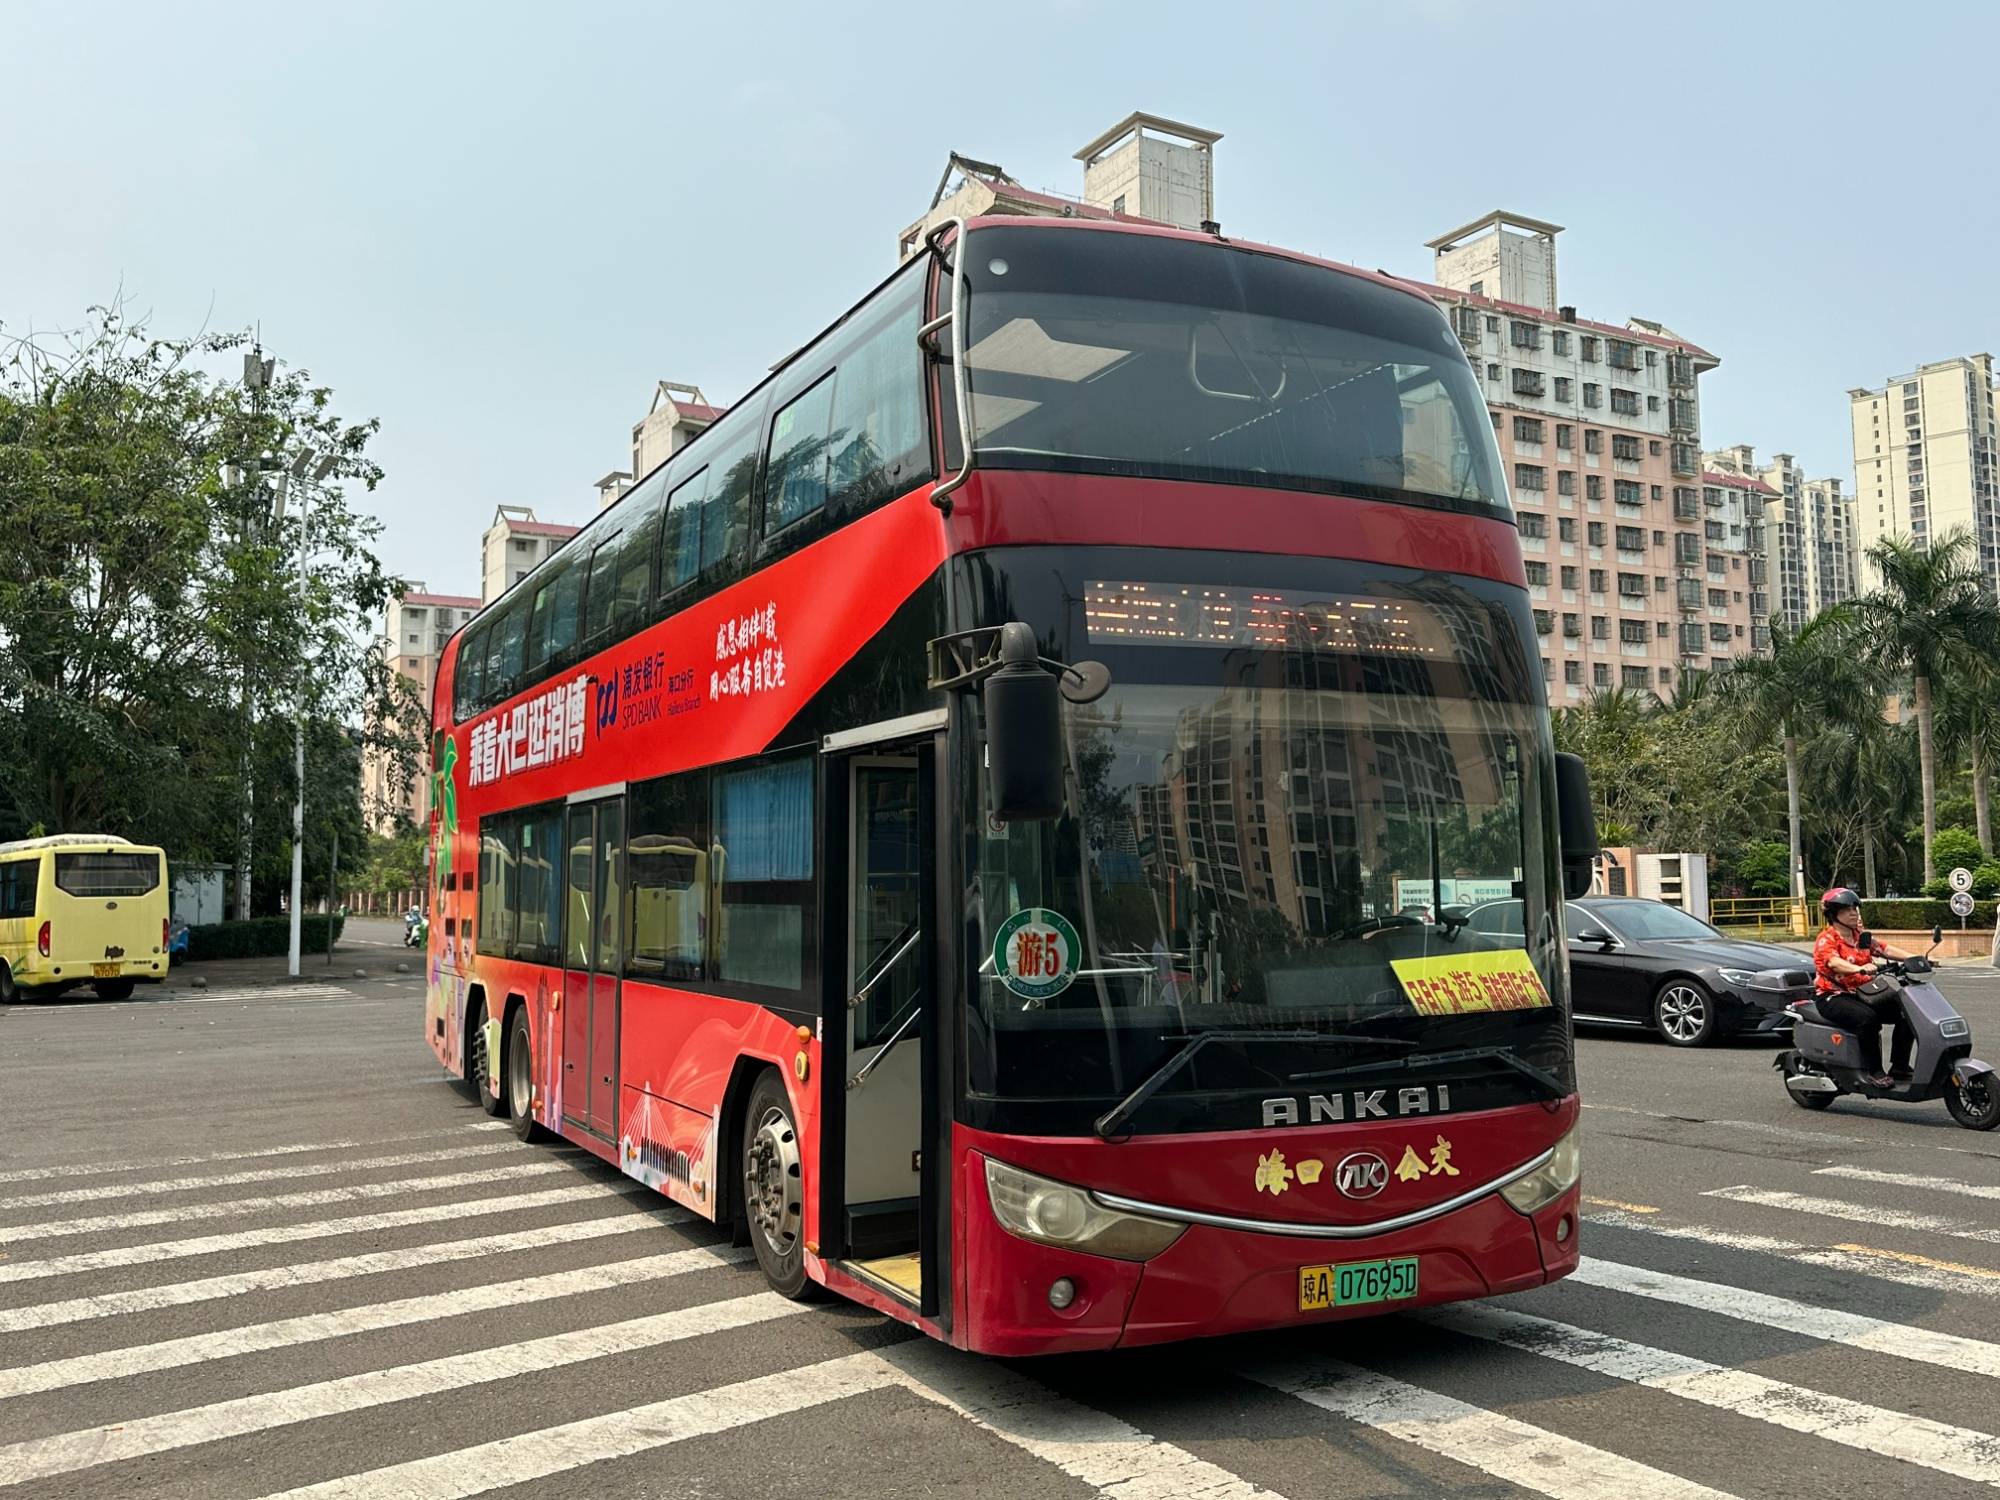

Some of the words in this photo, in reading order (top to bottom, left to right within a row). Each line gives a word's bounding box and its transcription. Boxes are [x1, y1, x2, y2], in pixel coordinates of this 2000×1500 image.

[622, 651, 665, 700] 浦发银行
[667, 668, 694, 696] 海口分行
[709, 644, 787, 702] 用心服务自贸港
[468, 673, 587, 788] 乘着大巴逛消博
[638, 693, 663, 725] BANK
[1956, 873, 1966, 886] 5
[95, 969, 120, 978] 57070
[1016, 931, 1060, 978] 游5
[1261, 1084, 1450, 1126] ANKAI
[1255, 1148, 1325, 1196] 海口
[1394, 1134, 1461, 1183] 公交
